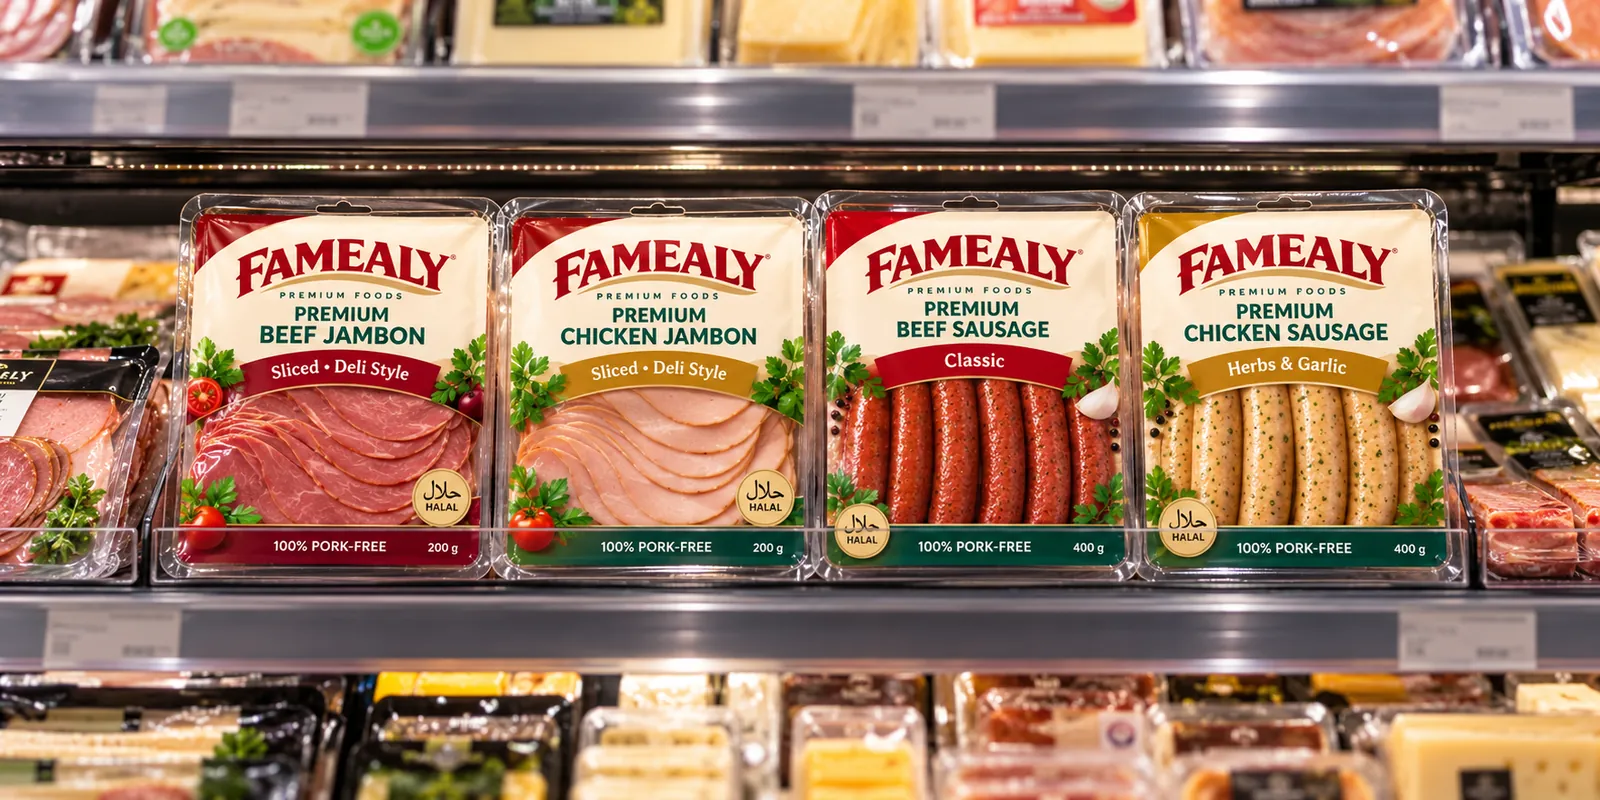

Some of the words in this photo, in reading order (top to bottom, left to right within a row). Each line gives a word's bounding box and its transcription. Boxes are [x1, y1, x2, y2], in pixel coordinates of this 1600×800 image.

[279, 291, 345, 299] PREMIUM
[354, 291, 402, 300] FOODS
[596, 292, 662, 301] PREMIUM
[671, 292, 719, 300] FOODS
[907, 286, 974, 295] PREMIUM
[983, 286, 1032, 295] FOODS
[1218, 287, 1287, 297] PREMIUM
[1296, 287, 1346, 296] FOODS
[295, 306, 388, 322] PREMIUM
[613, 308, 705, 323] PREMIUM
[925, 301, 1018, 316] PREMIUM
[1237, 303, 1333, 319] PREMIUM
[260, 326, 317, 344] BEEF
[323, 326, 424, 345] JAMBON
[561, 328, 656, 345] CHICKEN
[663, 328, 756, 345] JAMBON
[897, 321, 946, 337] BEEF
[953, 321, 1049, 338] SAUSAGE
[1184, 324, 1280, 342] CHICKEN
[1288, 323, 1388, 341] SAUSAGE
[944, 352, 1005, 368] Classic
[1227, 357, 1276, 377] Herbs
[1280, 356, 1293, 371] &
[1297, 356, 1347, 375] Garlic
[271, 359, 320, 380] Sliced
[334, 359, 367, 375] Deli
[370, 361, 409, 381] Style
[591, 360, 639, 381] Sliced
[653, 360, 684, 375] Deli
[688, 361, 727, 381] Style
[423, 479, 462, 500] حلال
[746, 479, 785, 500] حلال
[425, 503, 459, 512] HALAL
[749, 503, 783, 512] HALAL
[844, 514, 880, 534] حلال
[1168, 508, 1207, 529] حلال
[846, 536, 878, 545] HALAL
[1172, 533, 1205, 542] HALAL
[273, 540, 308, 552] 100%
[311, 540, 387, 552] PORK-FREE
[427, 542, 449, 553] 200
[451, 545, 459, 555] g
[600, 541, 635, 553] 100%
[638, 541, 712, 553] PORK-FREE
[752, 542, 774, 553] 200
[776, 545, 784, 556] g
[918, 540, 953, 553] 100%
[956, 540, 1032, 553] PORK-FREE
[1072, 542, 1095, 553] 400
[1097, 544, 1105, 555] g
[1236, 542, 1272, 554] 100%
[1275, 542, 1353, 554] PORK-FREE
[1393, 543, 1416, 554] 400
[1418, 546, 1426, 557] g
